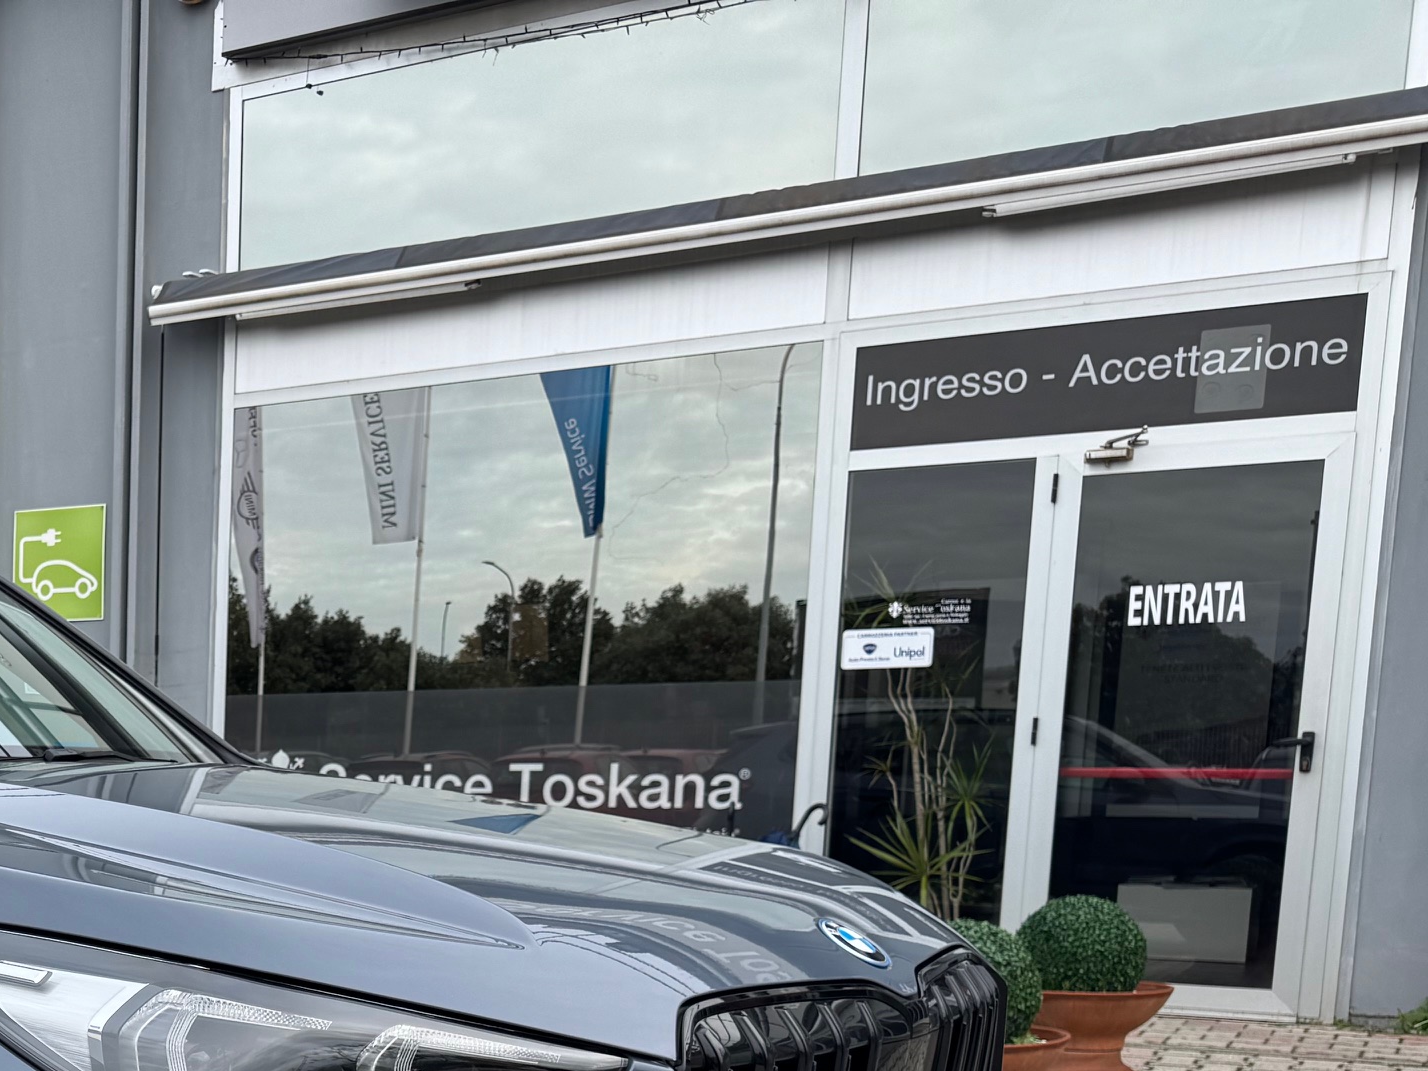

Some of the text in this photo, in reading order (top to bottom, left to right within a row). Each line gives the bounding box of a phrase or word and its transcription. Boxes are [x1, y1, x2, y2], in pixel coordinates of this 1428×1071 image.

[866, 337, 1348, 412] Ingresso - Accettazione
[1127, 580, 1246, 626] ENTRATA
[893, 645, 925, 660] Unipol
